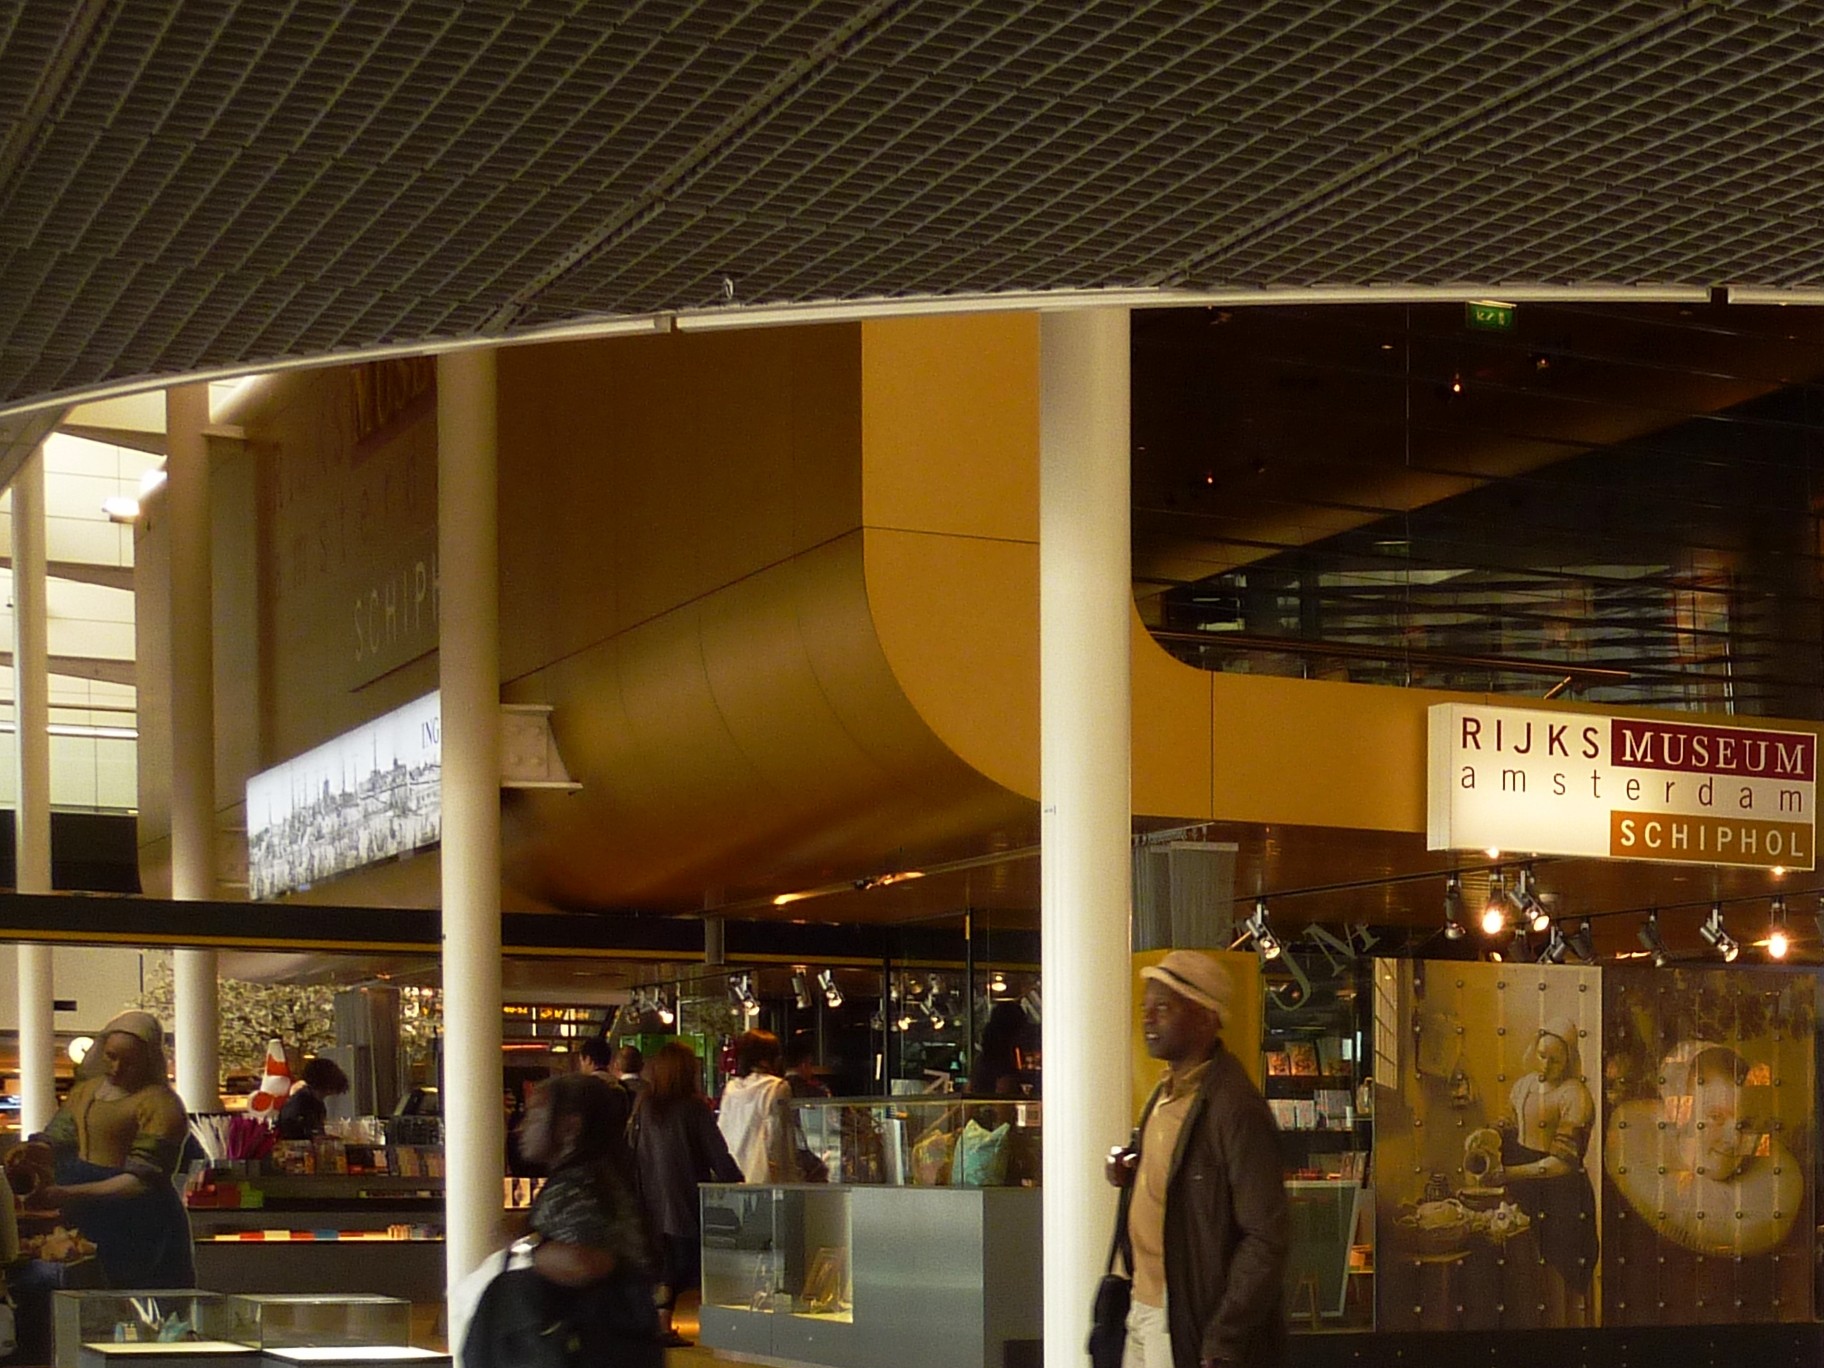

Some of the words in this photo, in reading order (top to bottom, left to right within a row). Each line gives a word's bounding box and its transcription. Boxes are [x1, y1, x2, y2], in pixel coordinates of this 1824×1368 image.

[1461, 716, 1600, 759] RIJKS
[1621, 728, 1805, 775] MUSEUM
[1461, 764, 1803, 814] amsterdam
[1620, 818, 1804, 858] SCHIPHOL
